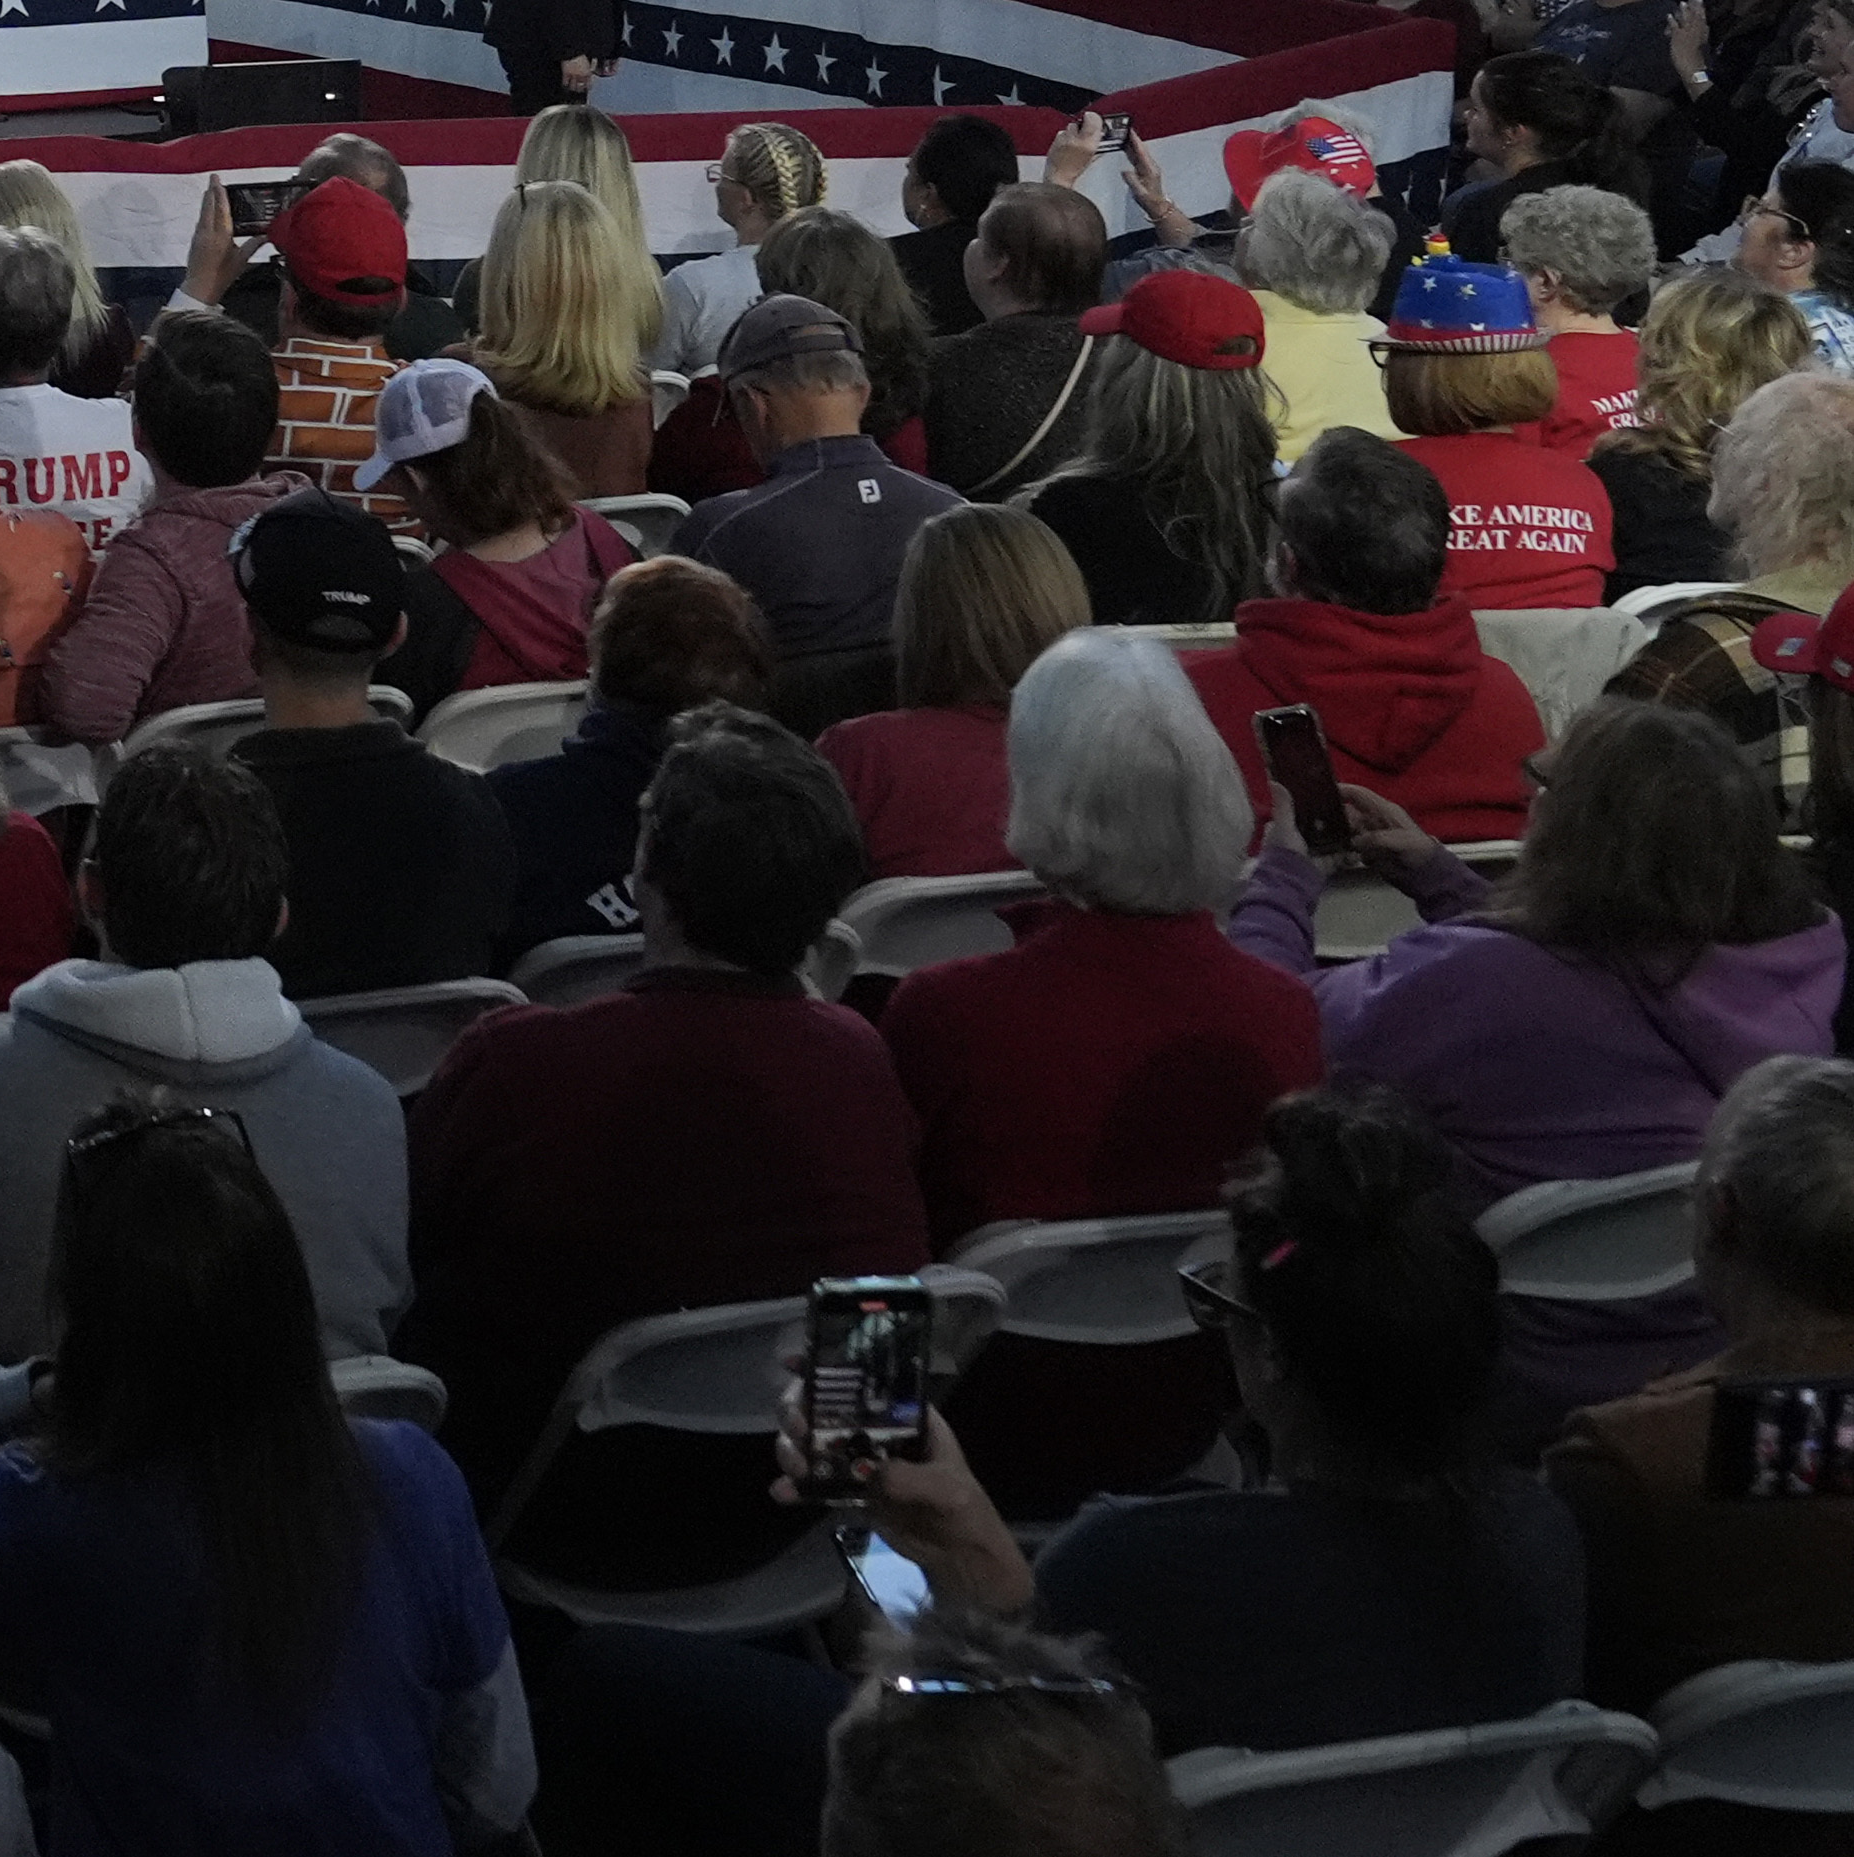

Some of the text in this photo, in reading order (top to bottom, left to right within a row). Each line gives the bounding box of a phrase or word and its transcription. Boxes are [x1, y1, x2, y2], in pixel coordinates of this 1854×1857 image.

[1448, 504, 1595, 532] KE AMERICA
[1445, 529, 1588, 554] REAT AGAIN
[322, 590, 370, 605] TRUMP
